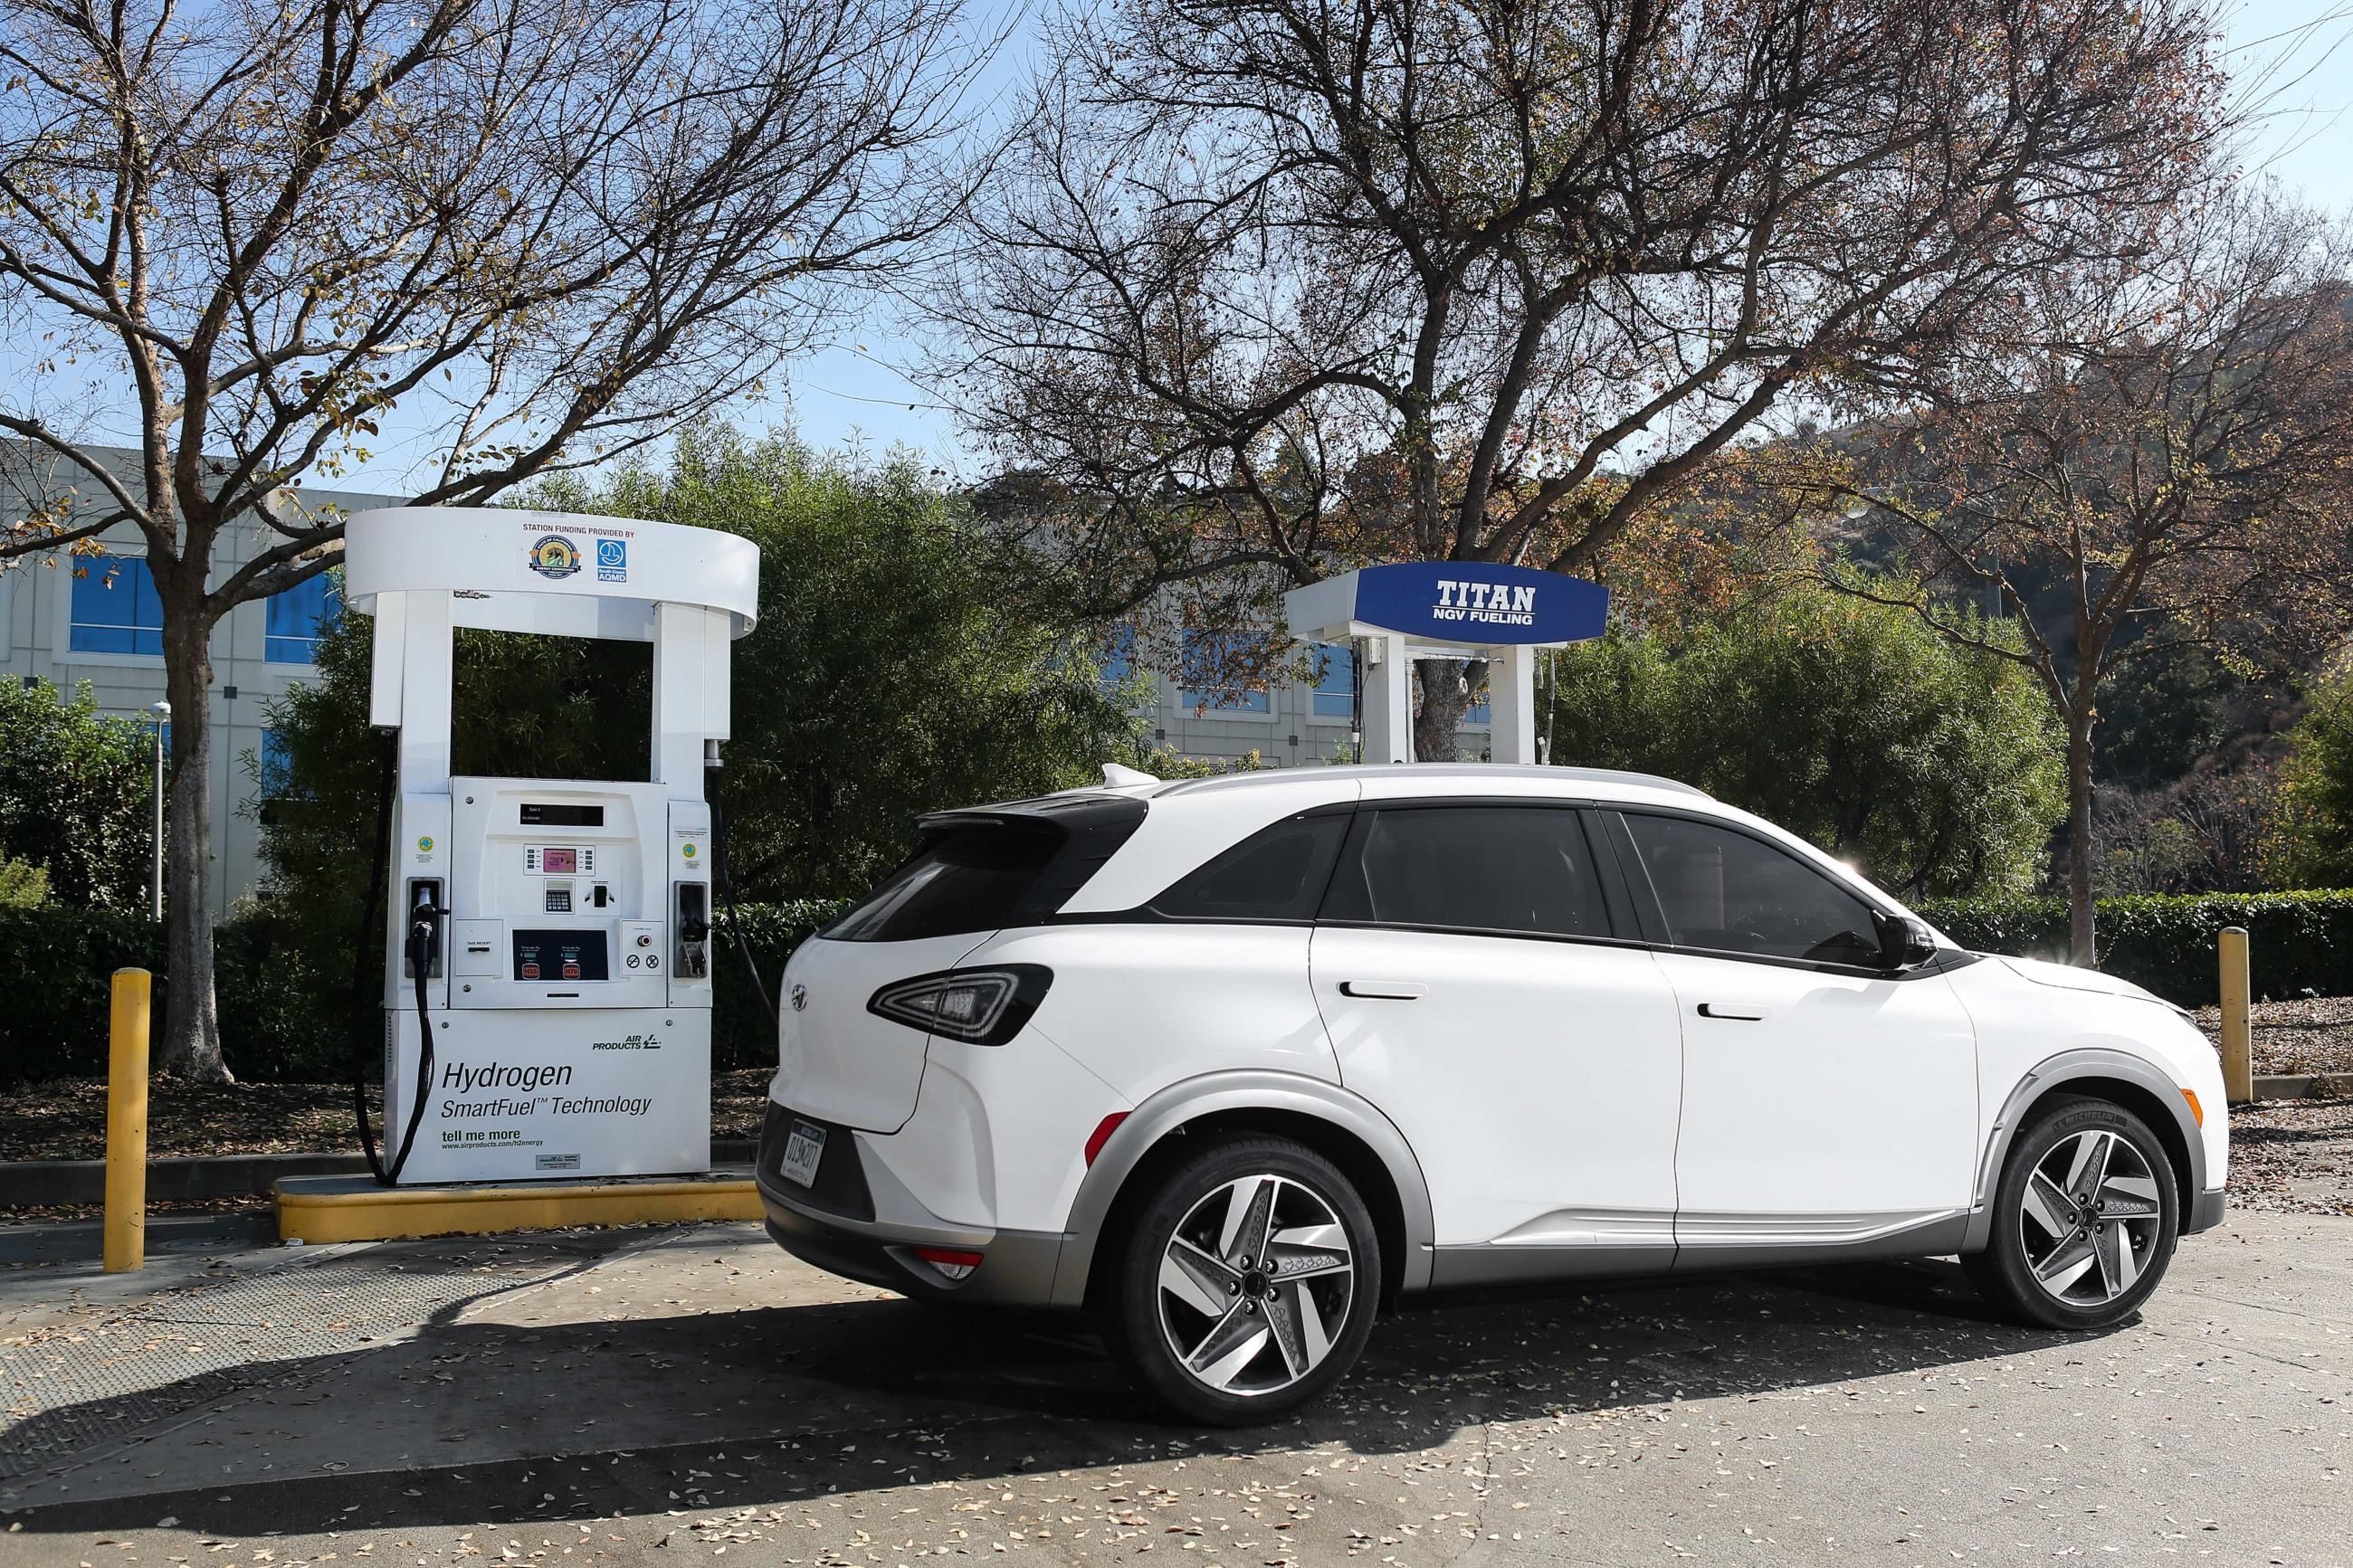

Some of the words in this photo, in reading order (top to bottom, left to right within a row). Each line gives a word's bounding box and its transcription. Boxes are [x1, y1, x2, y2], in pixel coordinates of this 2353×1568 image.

[523, 523, 554, 532] STATION
[555, 525, 586, 535] FUNDING
[588, 527, 624, 537] PROVIDED
[598, 573, 626, 582] AQMD
[1437, 580, 1536, 612] TITAN
[1433, 608, 1466, 621] NGV
[1469, 611, 1533, 625] FUELING
[525, 967, 538, 975] H35
[592, 1042, 642, 1050] PRODUCTS
[442, 1061, 573, 1093] Hydrogen
[551, 1095, 653, 1116] Technology
[2064, 1110, 2115, 1126] MICHELIN
[442, 1130, 462, 1142] tell
[465, 1131, 485, 1141] me
[489, 1129, 520, 1140] more
[442, 1139, 544, 1149] www.airproducts.com/h2energy
